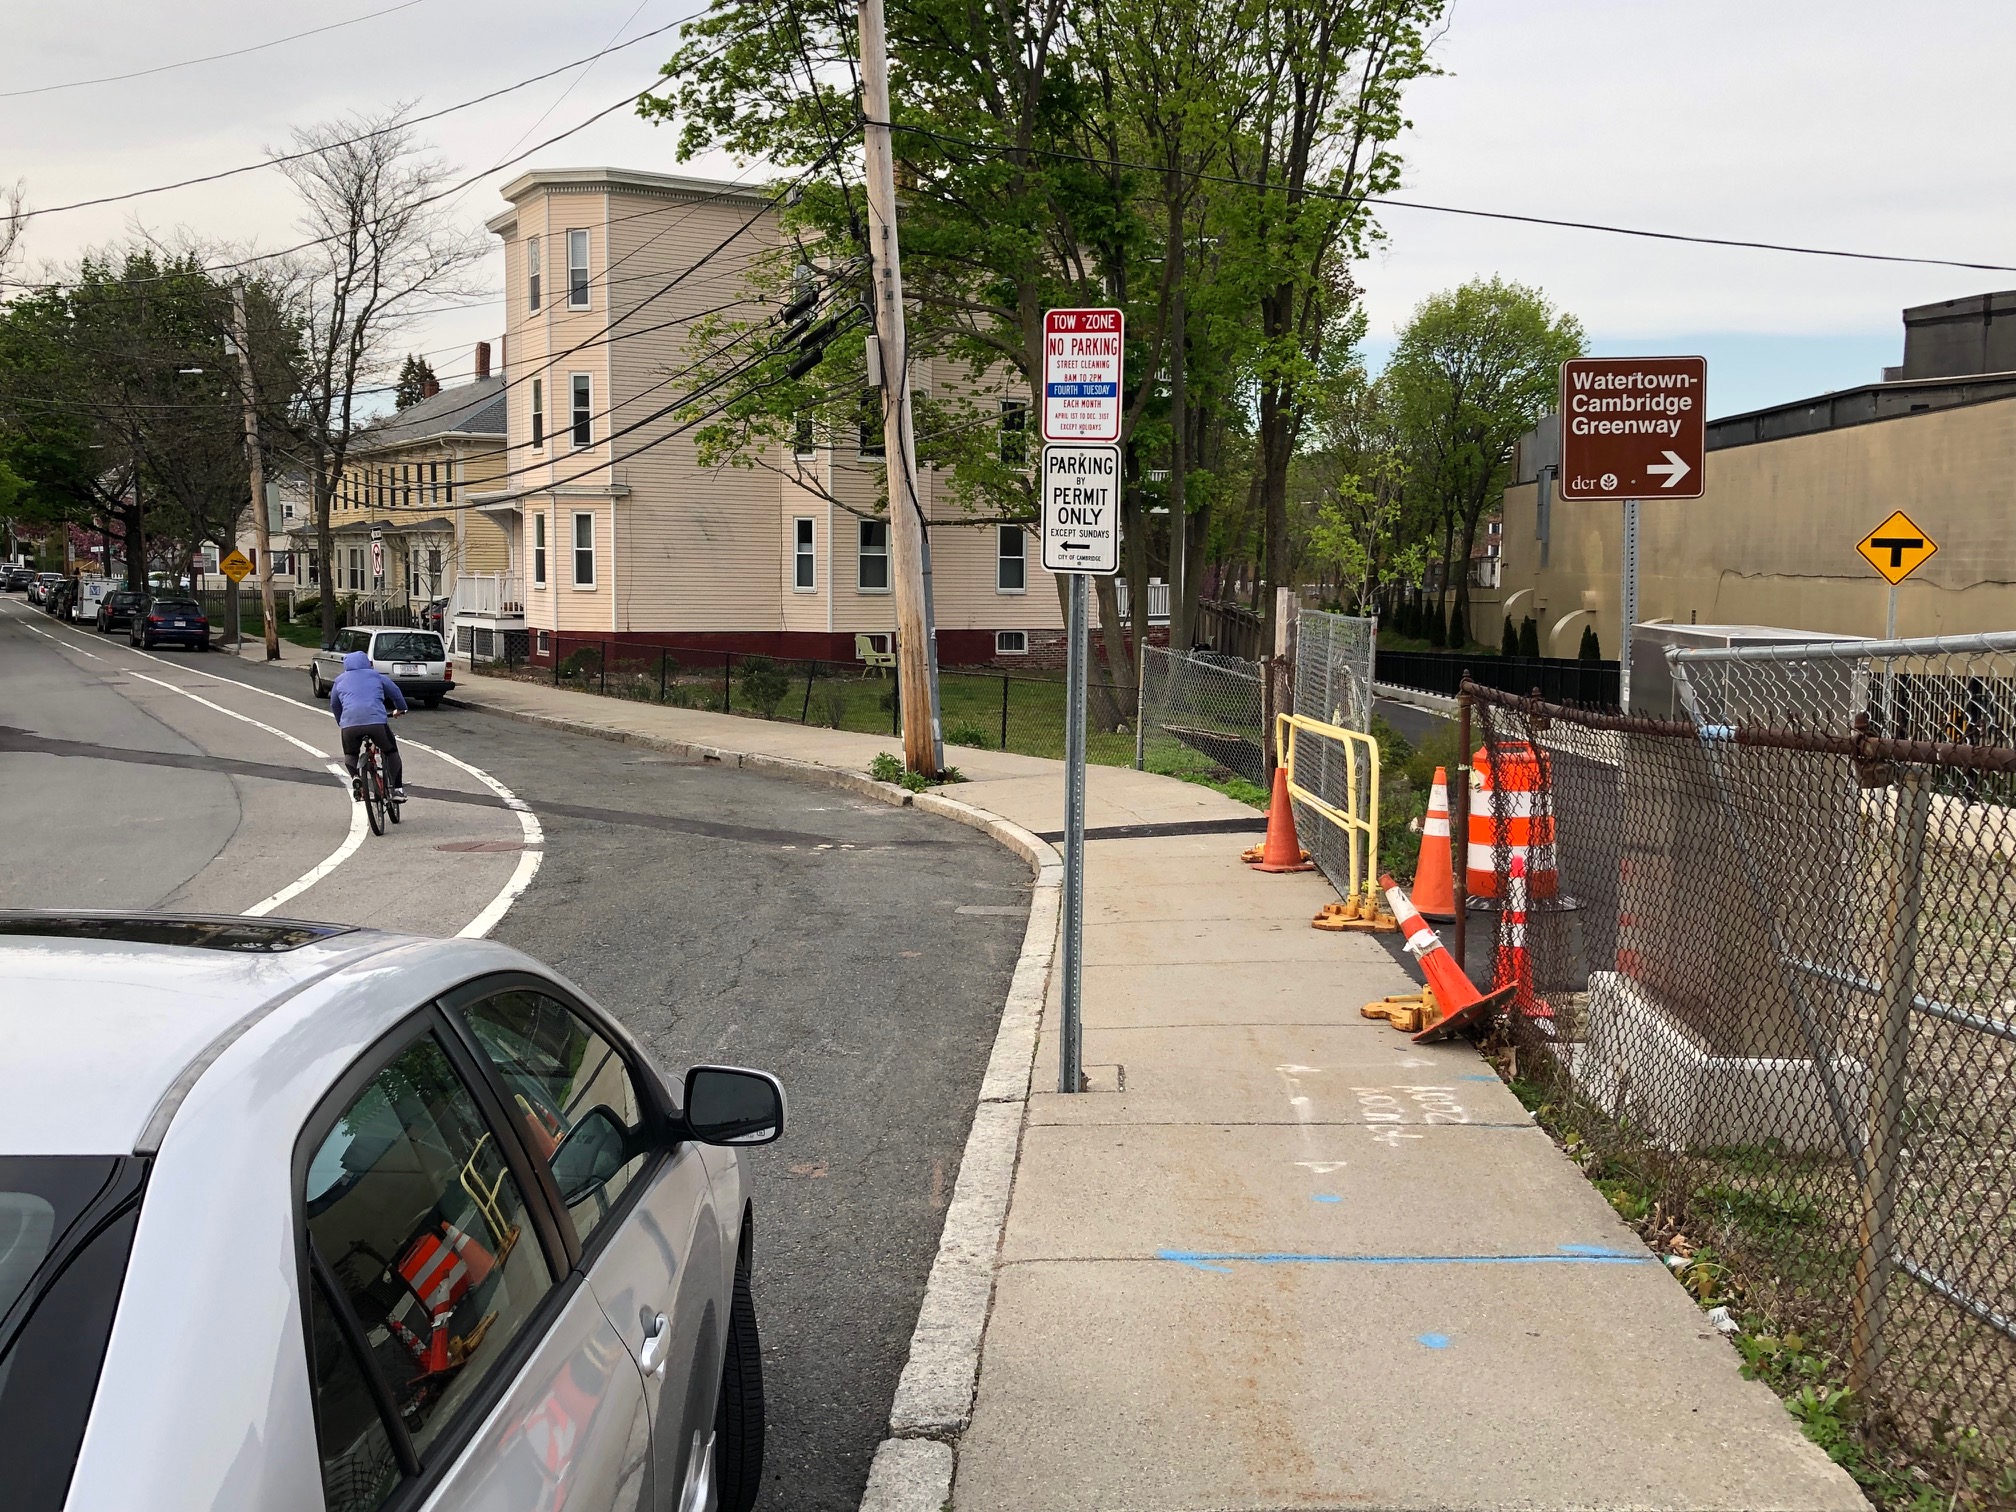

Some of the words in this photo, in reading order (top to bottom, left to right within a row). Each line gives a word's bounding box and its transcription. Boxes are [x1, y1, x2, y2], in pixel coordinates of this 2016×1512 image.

[1053, 315, 1076, 329] TOW
[1086, 314, 1116, 329] ZONE
[1050, 338, 1064, 356] NO
[1071, 338, 1118, 356] PARKING
[1056, 360, 1078, 368] STREET
[1080, 360, 1110, 368] CLEANING
[1064, 374, 1076, 382] 8AM
[1080, 374, 1087, 382] TO
[1089, 374, 1102, 382] 2PM
[1572, 372, 1698, 390] Watertown-
[1054, 385, 1078, 395] FOURTH
[1083, 384, 1110, 394] TUESDAY
[1064, 400, 1080, 408] EACH
[1080, 400, 1102, 408] MONTH
[1572, 393, 1692, 416] Cambridge
[1572, 416, 1682, 438] Greenway
[1050, 456, 1113, 475] PARKING
[1076, 477, 1086, 486] BY
[1571, 476, 1597, 490] dcr
[1054, 488, 1108, 506] PERMIT
[1058, 507, 1102, 526] ONLY
[1050, 528, 1076, 537] EXCEPT
[1079, 530, 1110, 538] SUNDAYS
